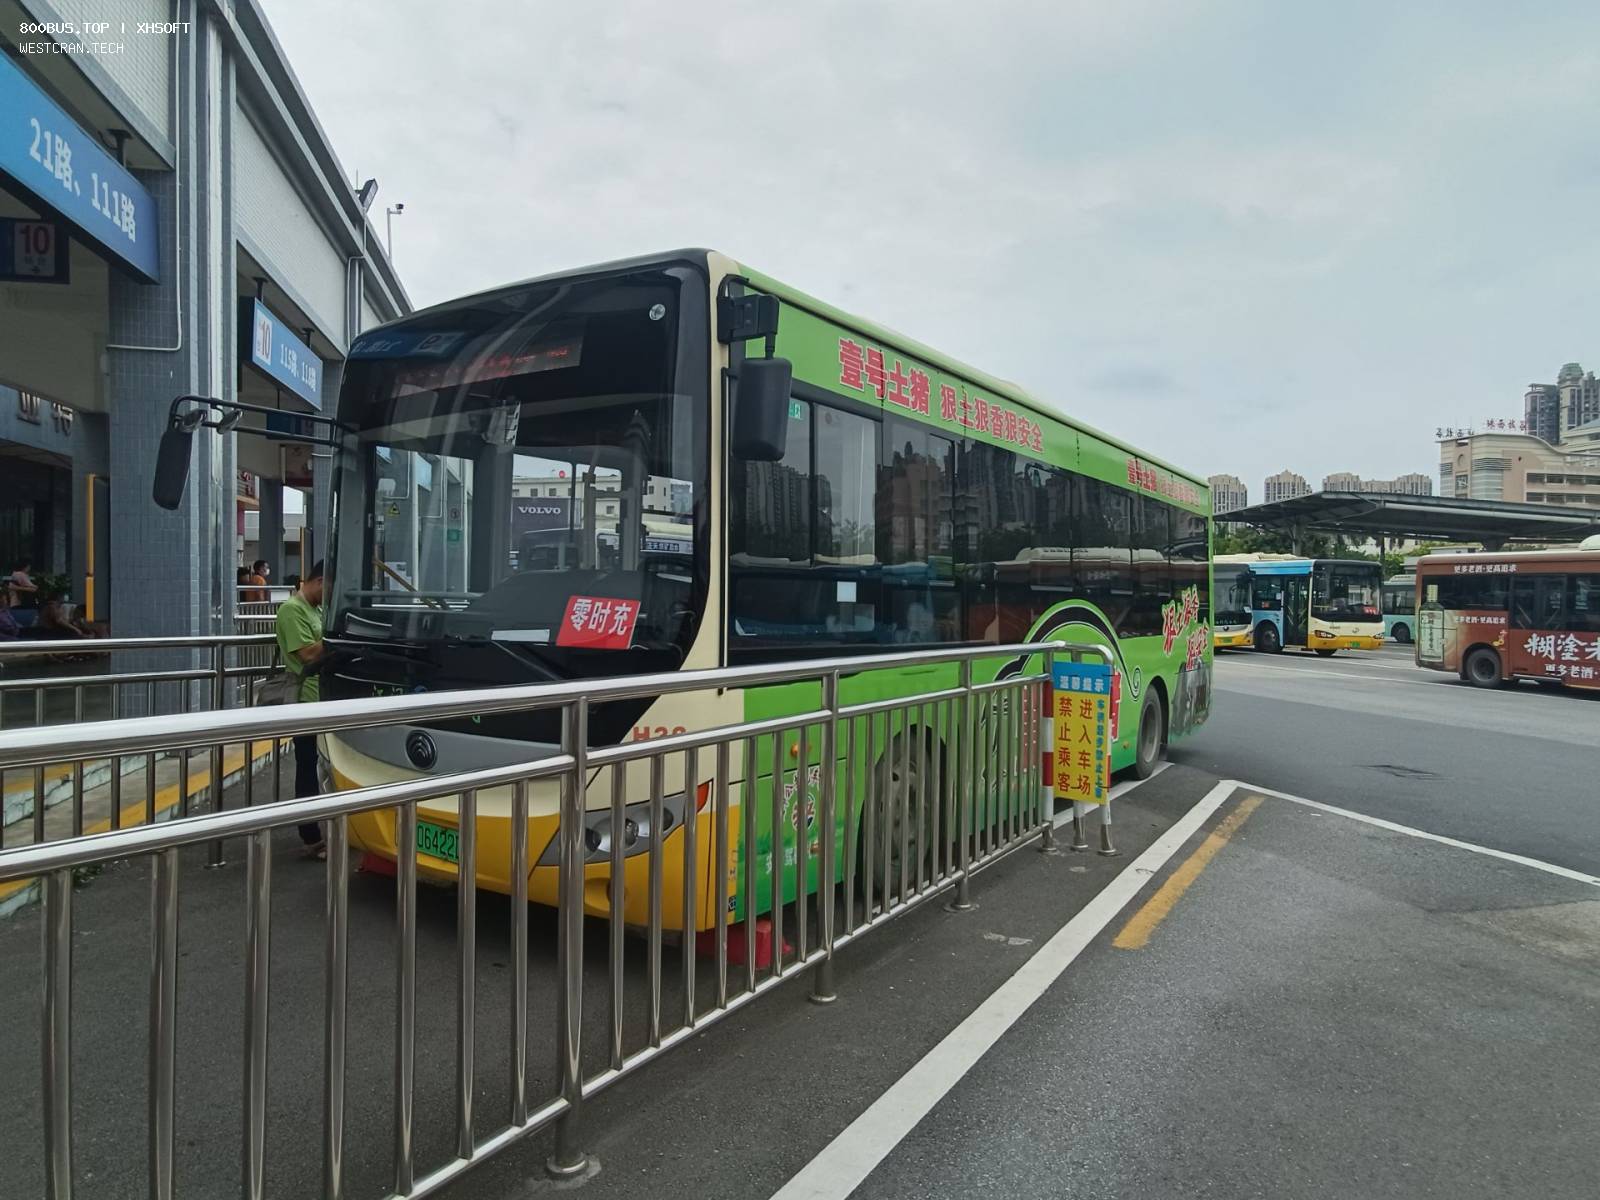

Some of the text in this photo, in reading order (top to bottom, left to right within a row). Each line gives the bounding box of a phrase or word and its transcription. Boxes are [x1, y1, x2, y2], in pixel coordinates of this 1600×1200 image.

[29, 117, 137, 244] 21路、111路
[20, 224, 50, 255] 10
[838, 337, 1044, 453] 壹号土猪 狠土狠香狠安全
[518, 505, 561, 515] VOLVO
[570, 598, 632, 635] 零时充
[1057, 696, 1073, 793] 禁止乘客
[1077, 699, 1093, 796] 进入车场
